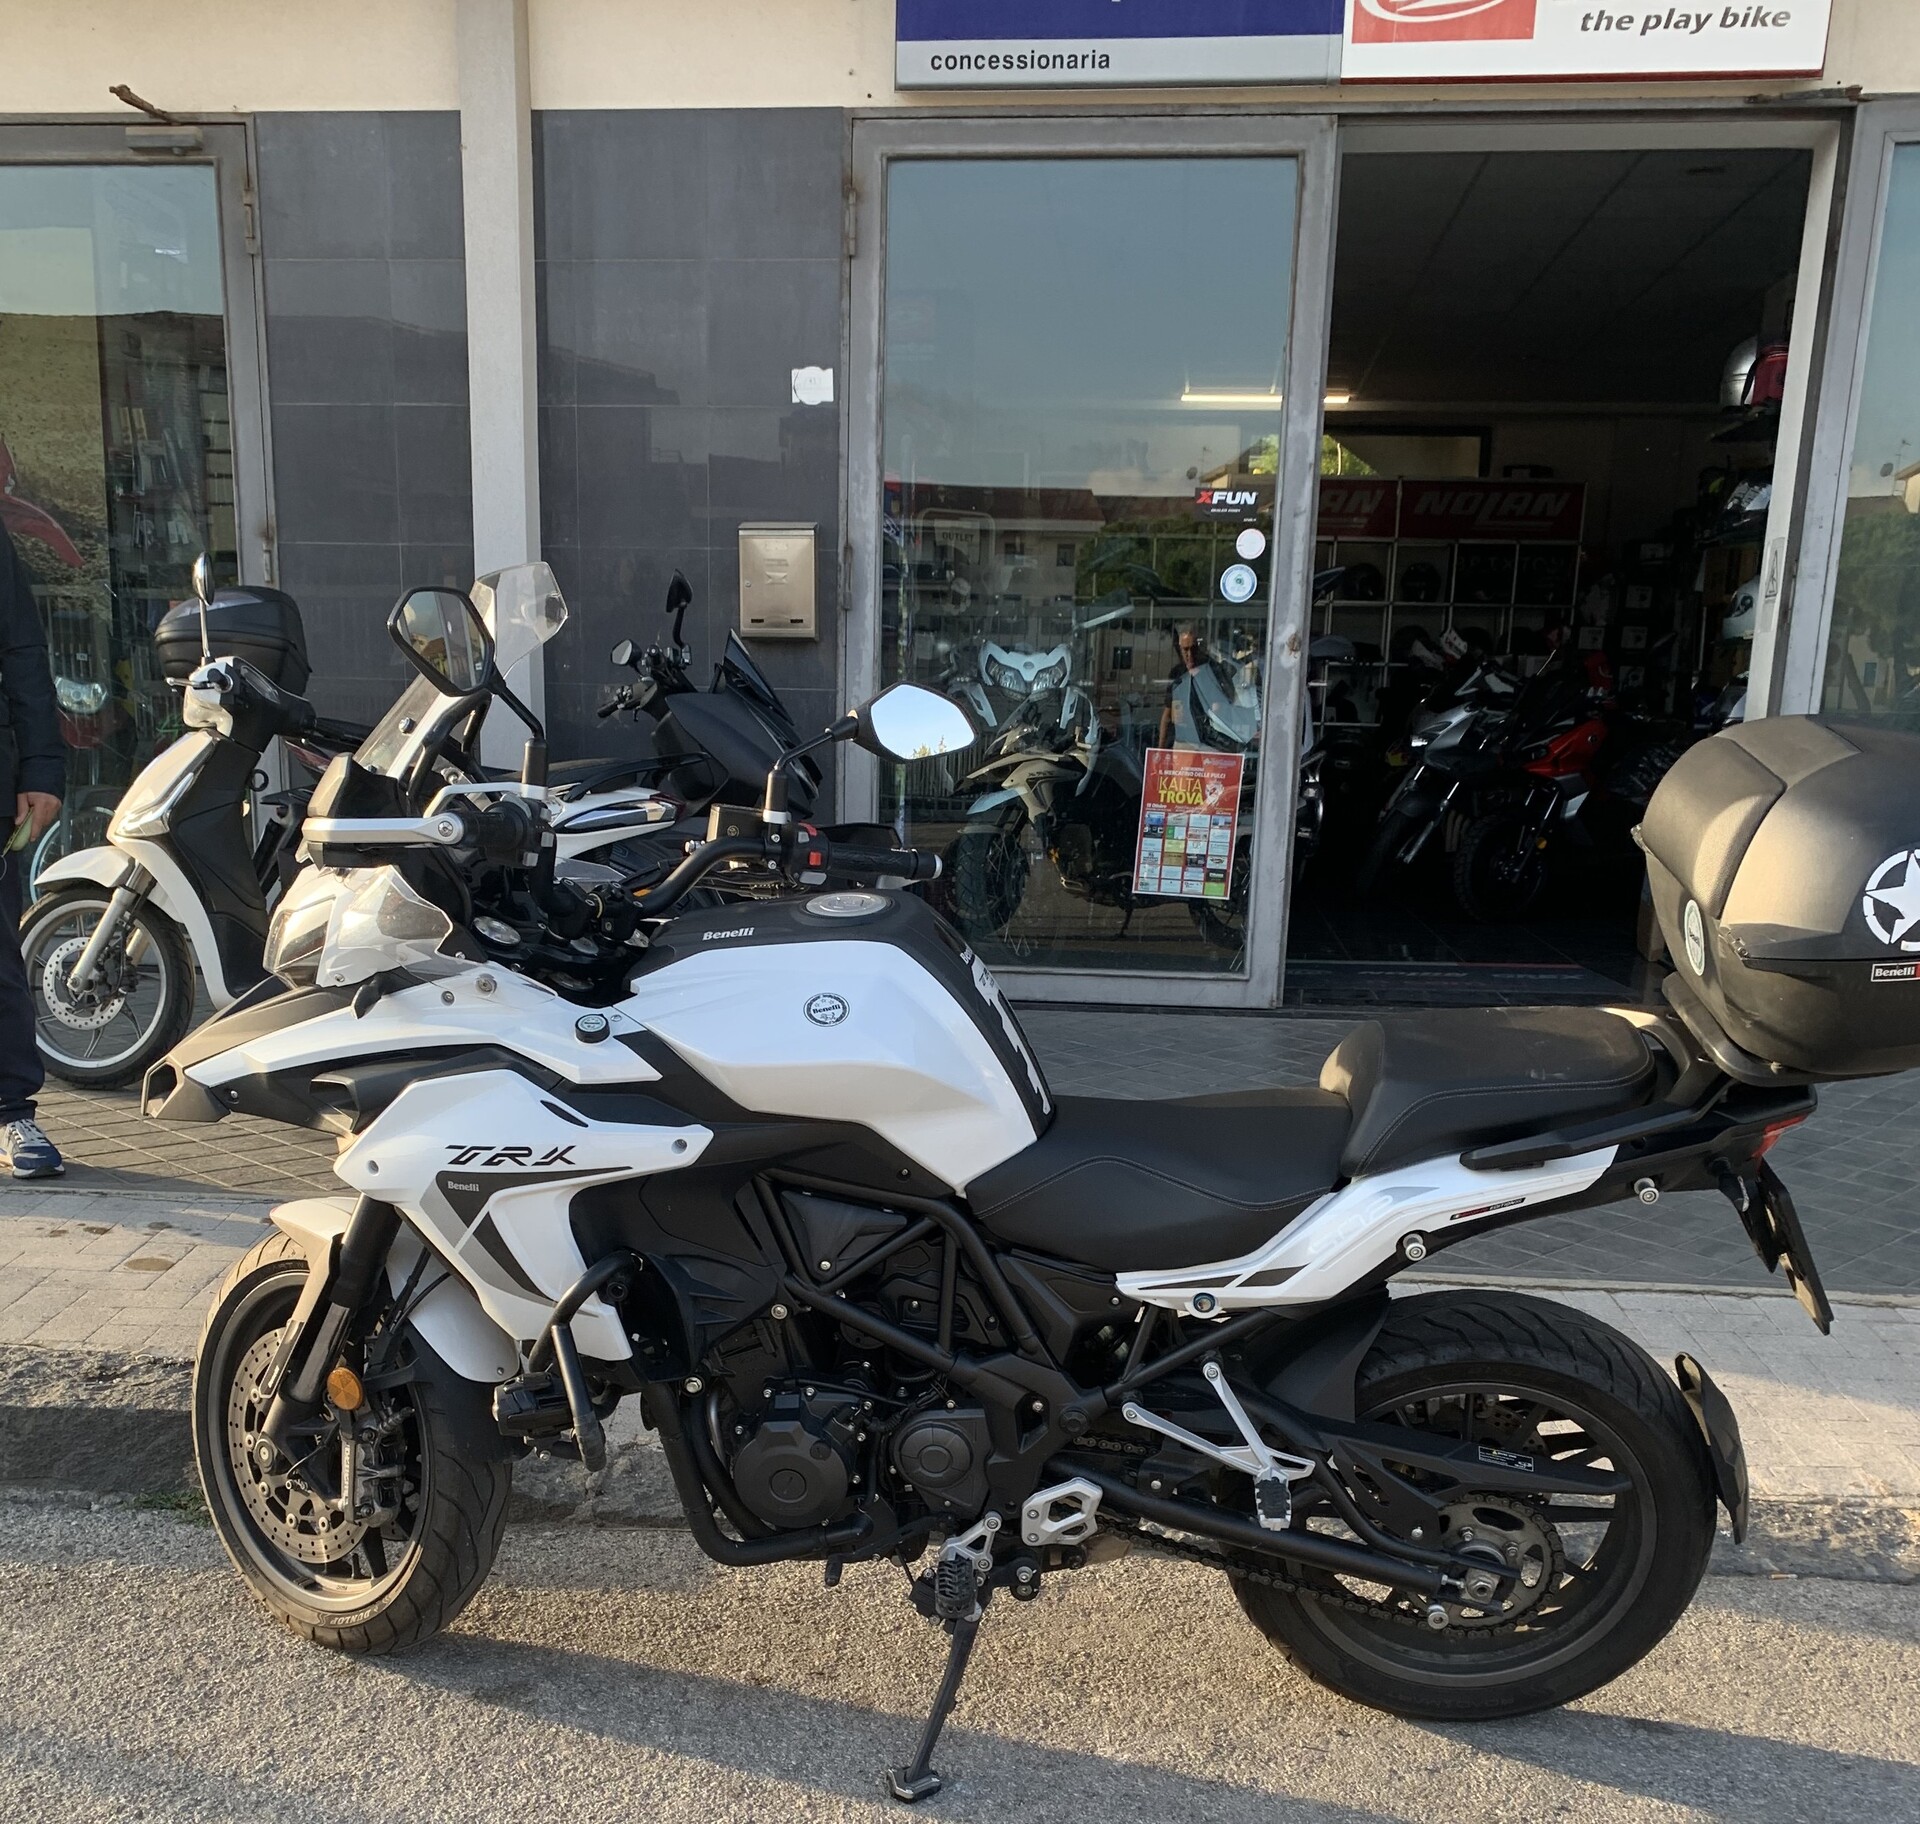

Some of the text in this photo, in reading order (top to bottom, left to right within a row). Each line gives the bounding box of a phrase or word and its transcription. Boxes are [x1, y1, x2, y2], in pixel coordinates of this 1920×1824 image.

[1580, 6, 1792, 36] the play bike
[930, 50, 1110, 71] concessionaria
[1195, 489, 1258, 505] XFUN
[1412, 491, 1573, 530] NOLAN
[942, 532, 975, 542] OUTLET
[1159, 776, 1202, 792] KALTA
[1158, 790, 1204, 805] TROVA
[702, 927, 755, 941] Benelli
[1875, 966, 1915, 977] Benelli
[812, 1004, 841, 1014] Benelli
[444, 1144, 577, 1167] TRK
[447, 1180, 480, 1192] Benelli
[329, 1609, 371, 1625] DUNLOP
